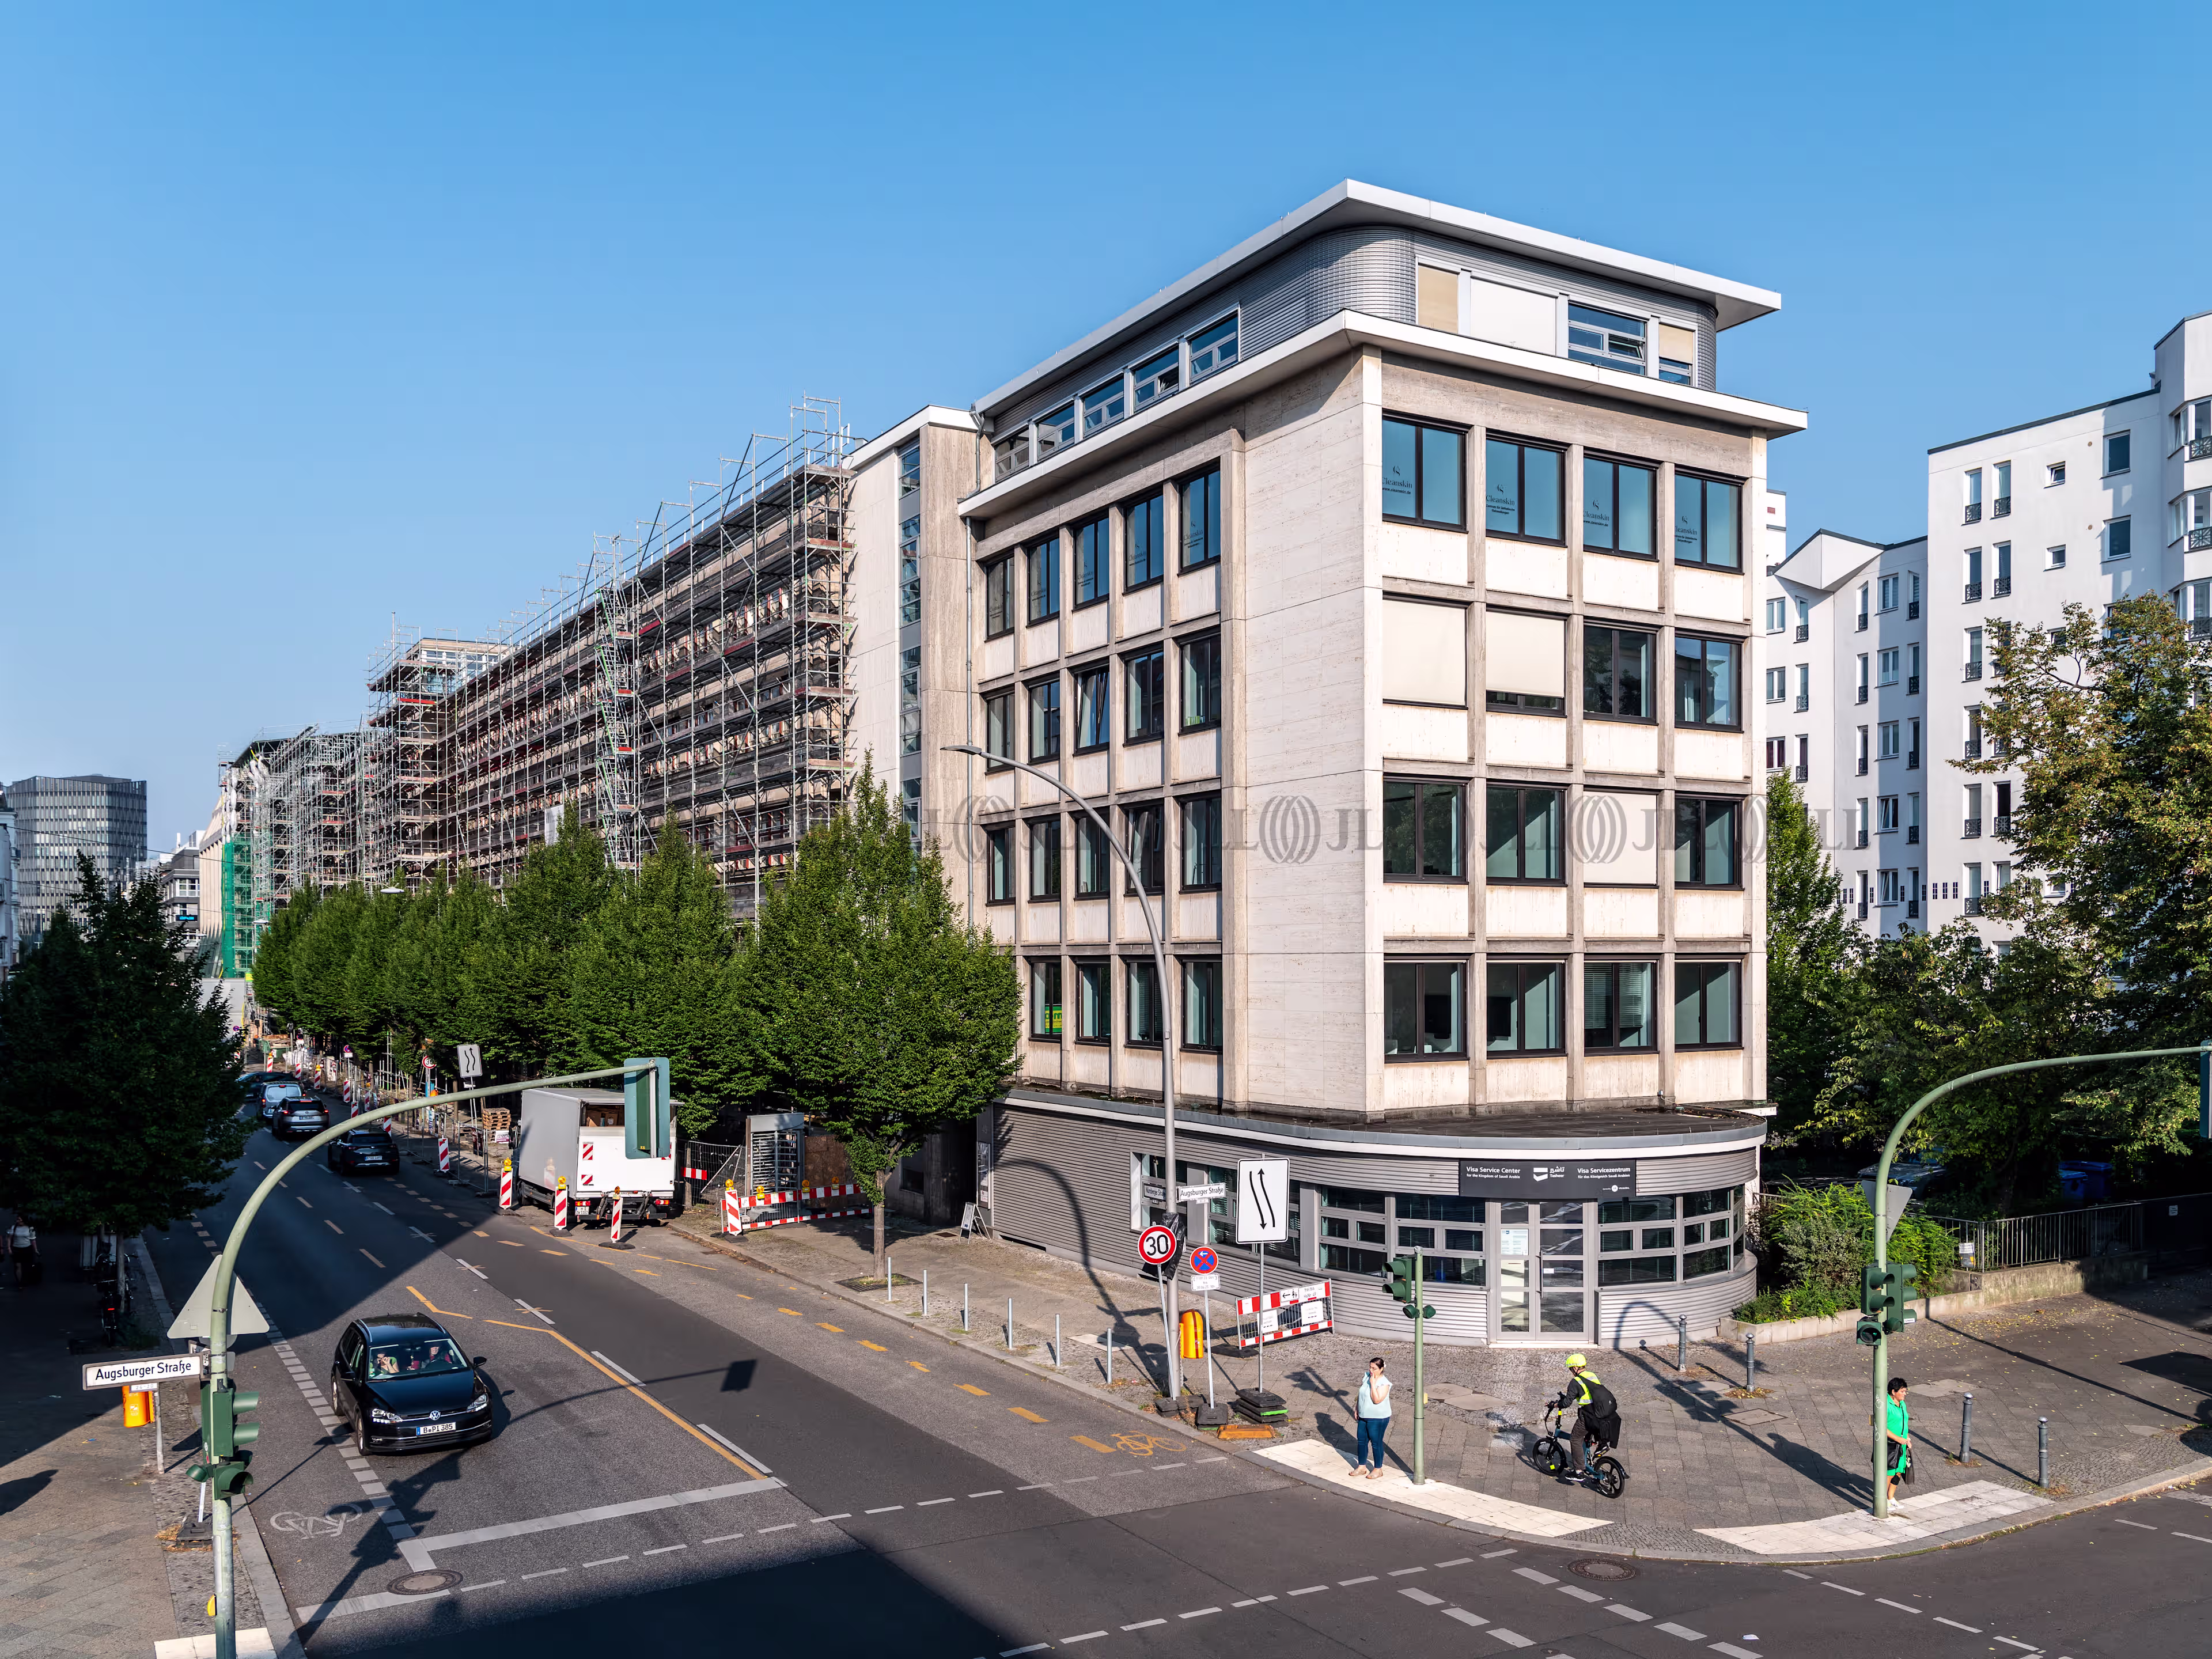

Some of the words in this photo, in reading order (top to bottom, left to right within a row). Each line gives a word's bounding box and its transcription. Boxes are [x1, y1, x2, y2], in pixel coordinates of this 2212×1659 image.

[1382, 477, 1412, 488] Cleanskin
[1486, 495, 1515, 505] Cleanskin
[1675, 525, 1698, 535] leanskin
[1145, 1186, 1158, 1196] Nürnberger
[1180, 1188, 1208, 1198] Augsburger
[1209, 1186, 1224, 1194] Straße
[1146, 1234, 1169, 1256] 30
[95, 1366, 156, 1381] Augsburger
[157, 1360, 191, 1374] Straße
